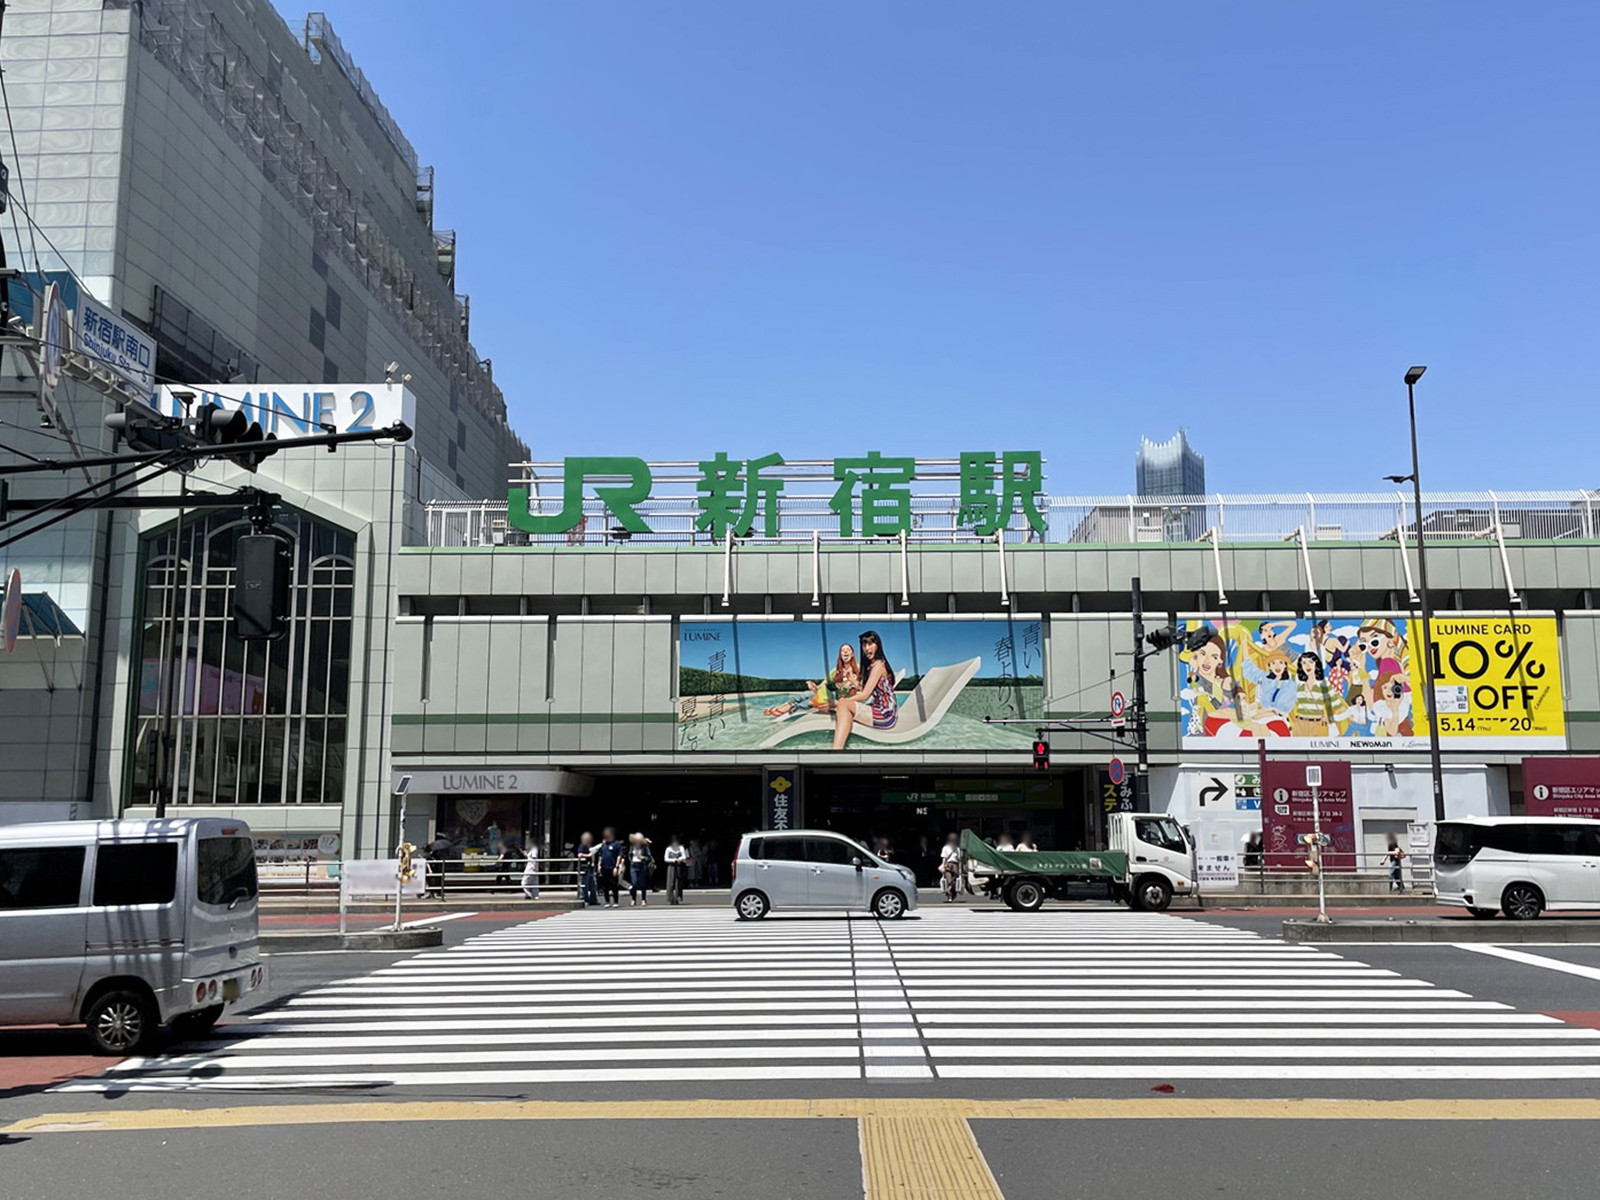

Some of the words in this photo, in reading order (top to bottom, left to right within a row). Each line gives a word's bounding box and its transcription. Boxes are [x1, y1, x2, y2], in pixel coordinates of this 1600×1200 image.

[83, 306, 150, 369] 新宿駅南口
[346, 391, 376, 432] 2
[508, 456, 652, 534] JR
[695, 450, 1047, 538] 新宿駅
[684, 632, 721, 641] LUMINE
[1022, 622, 1042, 669] 青い
[1436, 624, 1489, 636] LUMINE
[1493, 624, 1532, 635] CARD
[1430, 640, 1546, 680] 10%
[1473, 685, 1539, 711] OFF
[1440, 717, 1476, 732] 5.14
[1509, 717, 1532, 731] 20
[442, 775, 505, 791] LUMINE
[509, 774, 518, 790] 2
